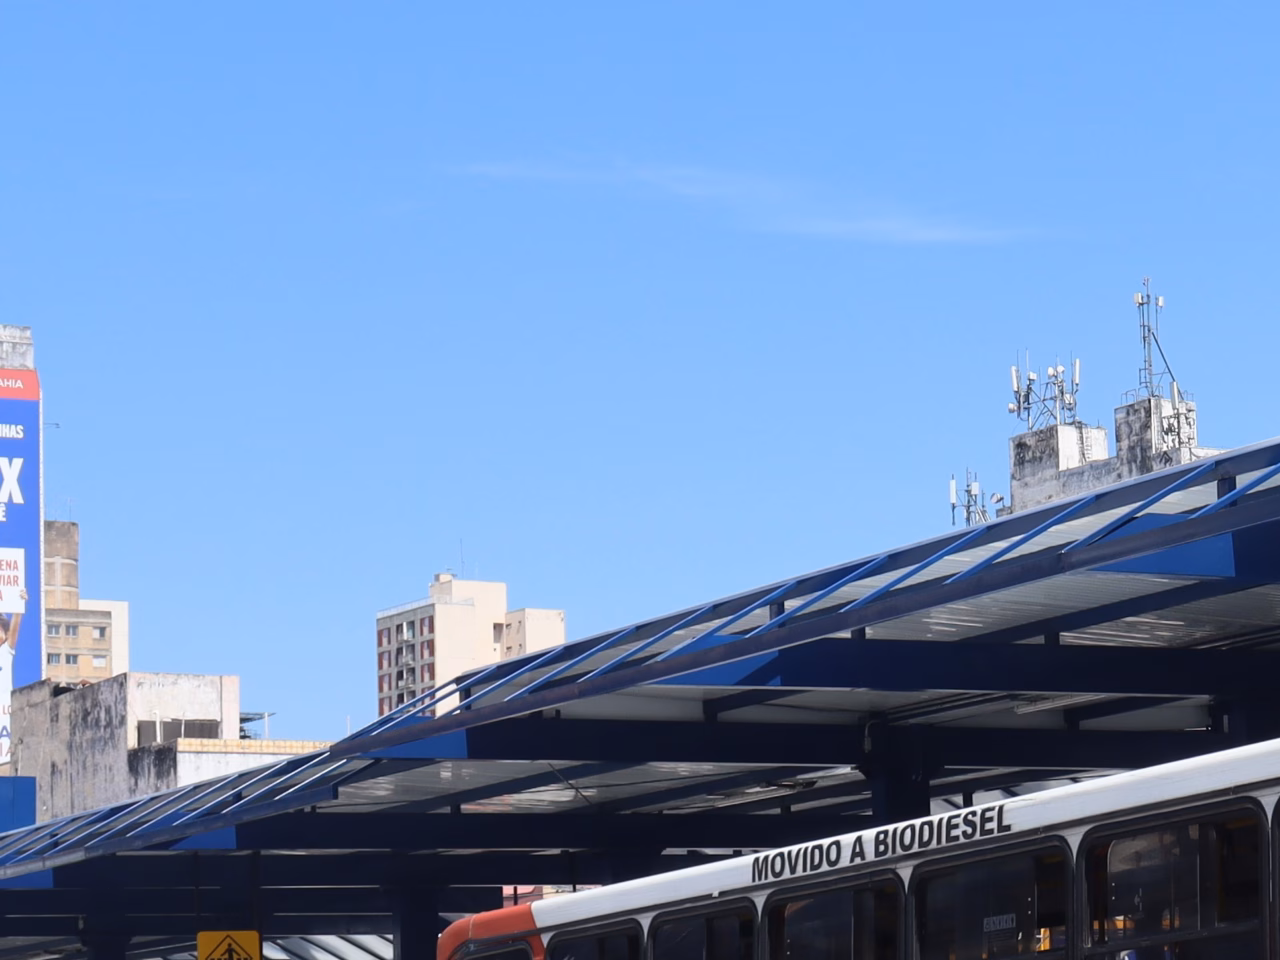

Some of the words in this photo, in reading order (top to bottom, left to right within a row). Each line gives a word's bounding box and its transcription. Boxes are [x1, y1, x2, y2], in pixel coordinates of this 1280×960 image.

[752, 840, 841, 883] MOVIDO
[849, 835, 866, 864] A
[874, 804, 1012, 859] BIODIESEL
